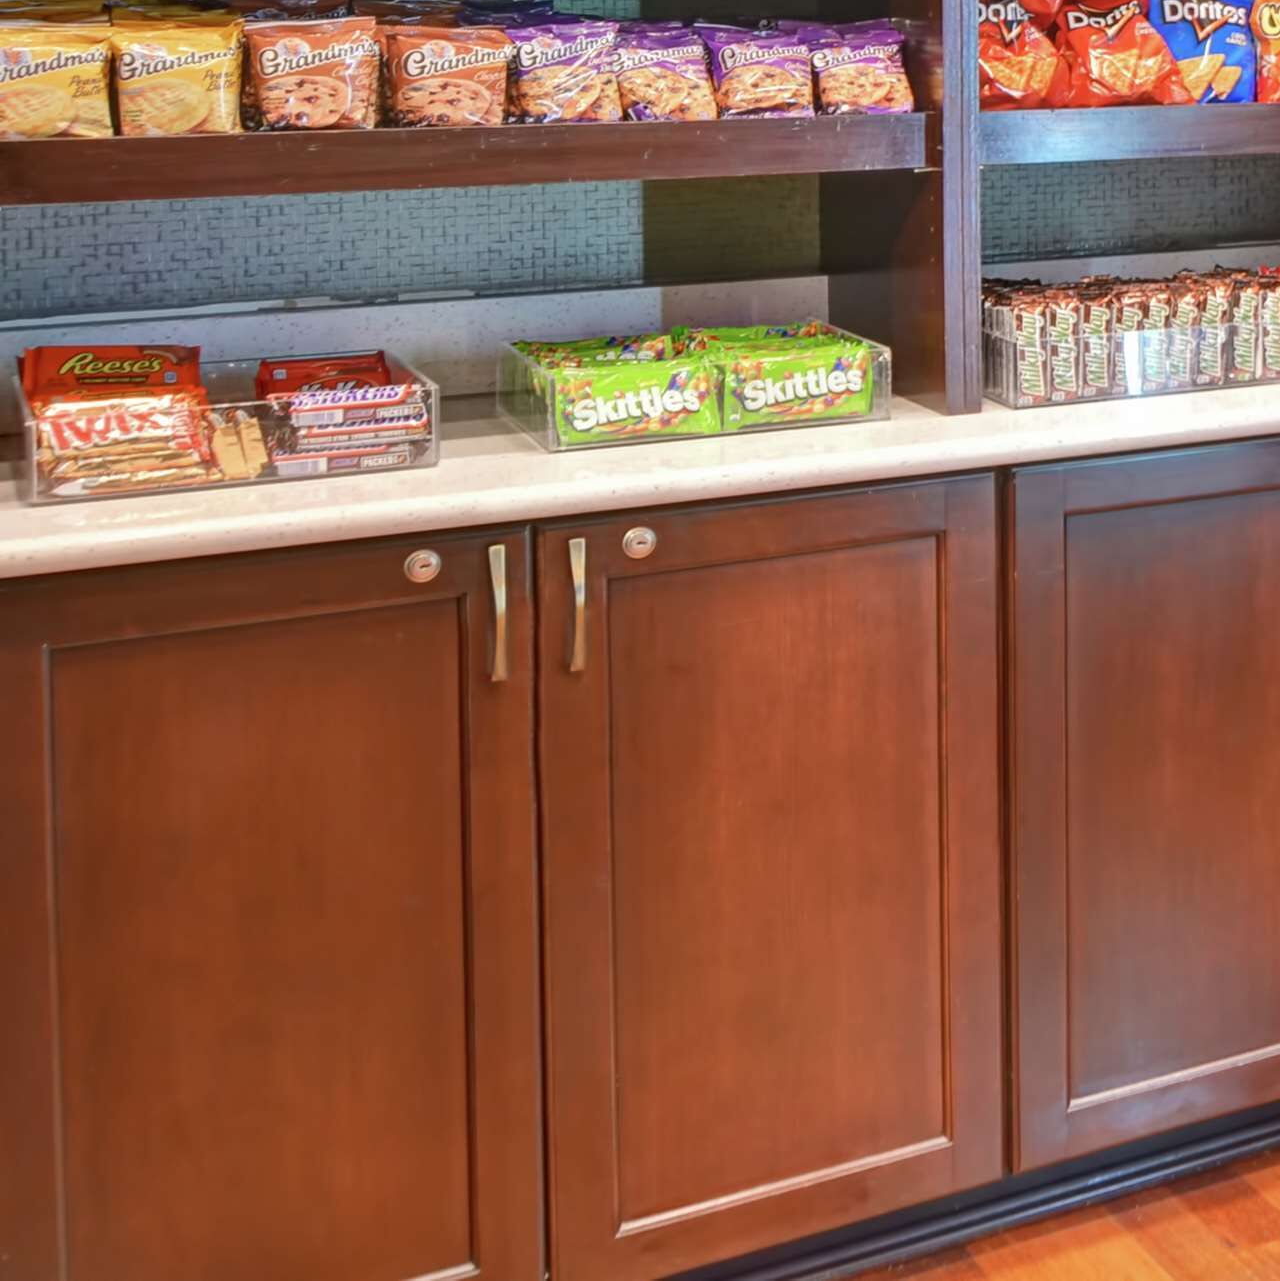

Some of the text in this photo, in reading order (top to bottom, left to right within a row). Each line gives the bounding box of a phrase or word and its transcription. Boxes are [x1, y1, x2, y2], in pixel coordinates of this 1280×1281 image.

[1067, 0, 1142, 30] Dorits
[0, 45, 108, 83] randma's
[258, 38, 380, 78] Grandma's
[571, 386, 701, 432] Skittles
[742, 367, 864, 412] Skittles
